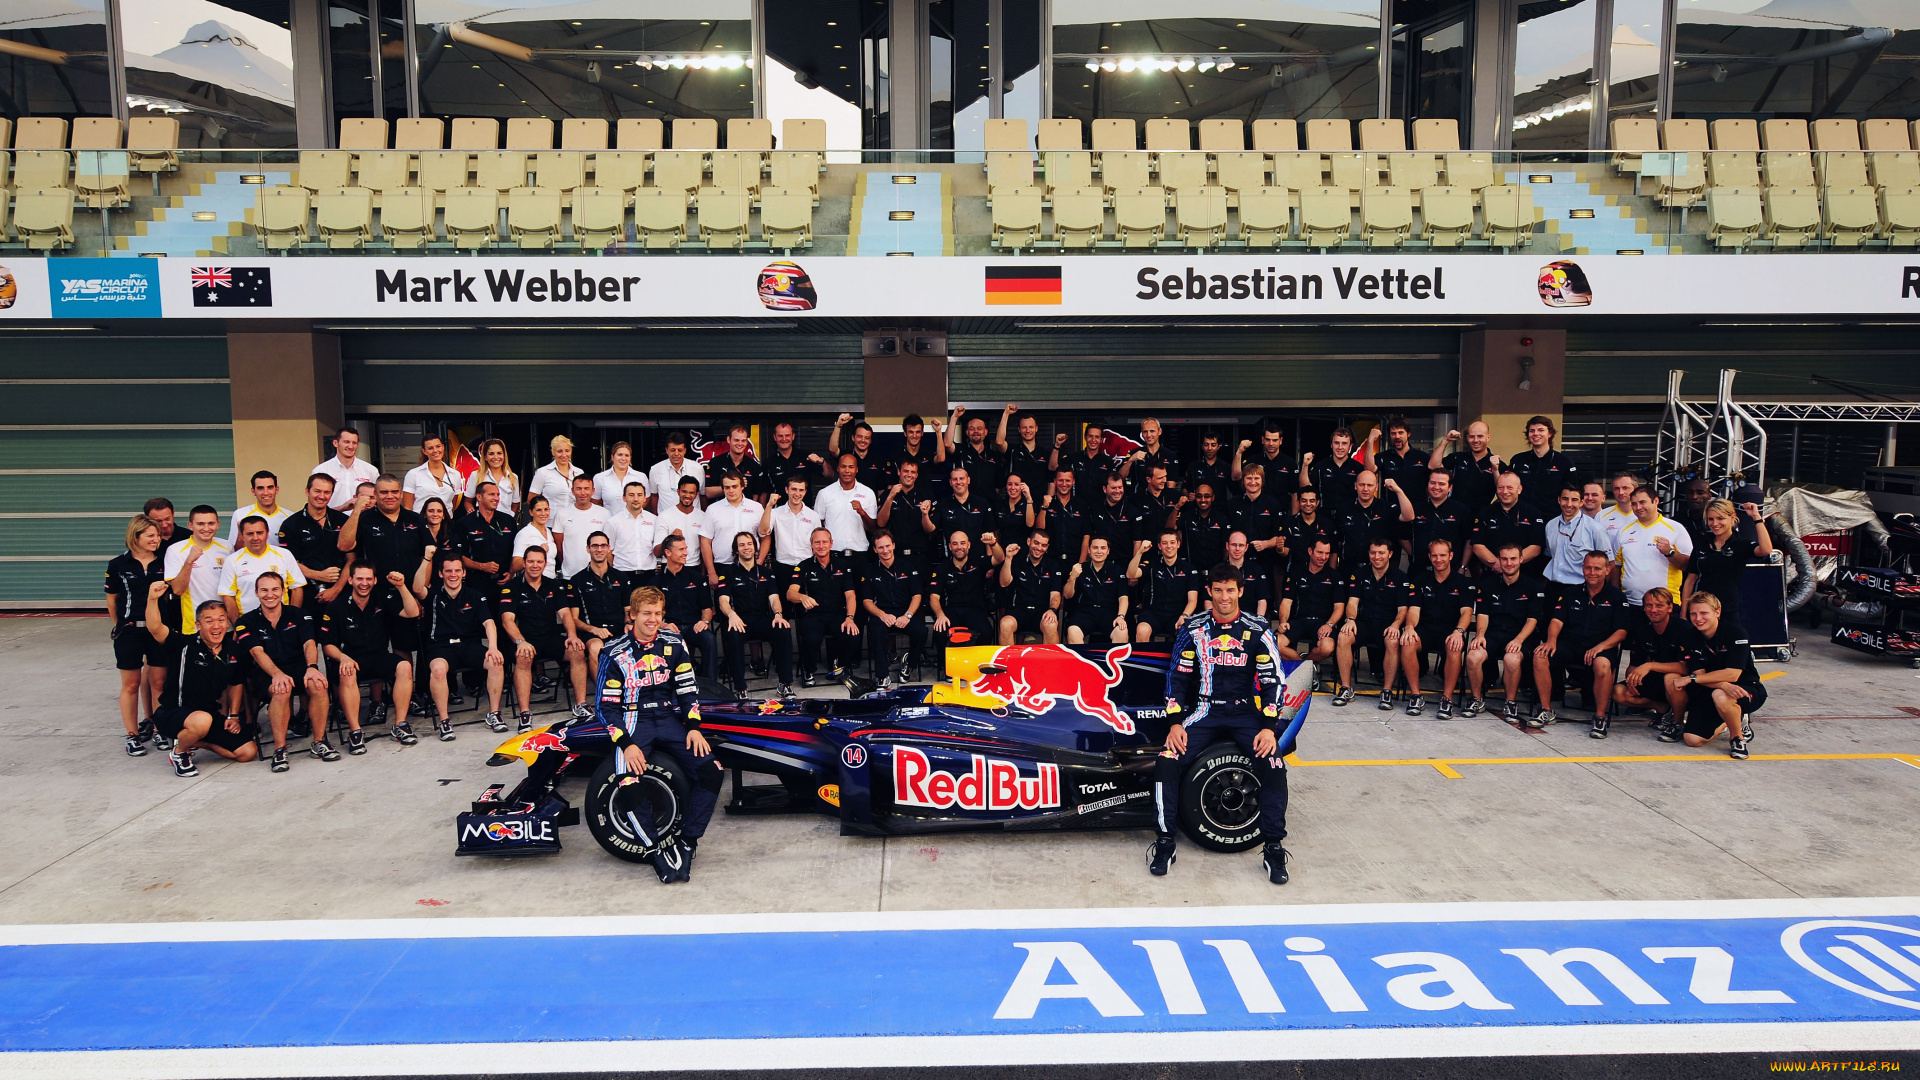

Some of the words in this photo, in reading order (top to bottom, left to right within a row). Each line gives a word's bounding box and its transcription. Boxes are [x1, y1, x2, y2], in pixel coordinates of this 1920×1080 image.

[60, 279, 102, 294] YAS
[102, 278, 148, 286] MARINA
[101, 286, 148, 294] CIRCUIT
[375, 268, 478, 303] Mark
[483, 268, 642, 303] Webber
[1135, 266, 1323, 300] Sebastian
[1332, 266, 1446, 300] Vettel
[1901, 265, 1920, 299] R
[1803, 543, 1837, 551] OTAL
[1201, 651, 1224, 666] Red
[1224, 652, 1248, 667] Bull
[625, 671, 652, 689] Red
[1282, 684, 1310, 709] ull
[1136, 709, 1167, 719] RENA
[846, 748, 862, 764] 14
[1206, 755, 1252, 771] BRIDGES
[1269, 757, 1283, 769] 14
[894, 746, 985, 809] Red
[988, 760, 1060, 809] Bull
[1078, 781, 1118, 795] TOTAL
[1127, 790, 1151, 800] SIEMENS
[461, 820, 555, 842] MOBILE
[1198, 824, 1261, 844] POTENZA
[608, 834, 675, 854] BRESTONE
[993, 936, 1795, 1020] Allianz
